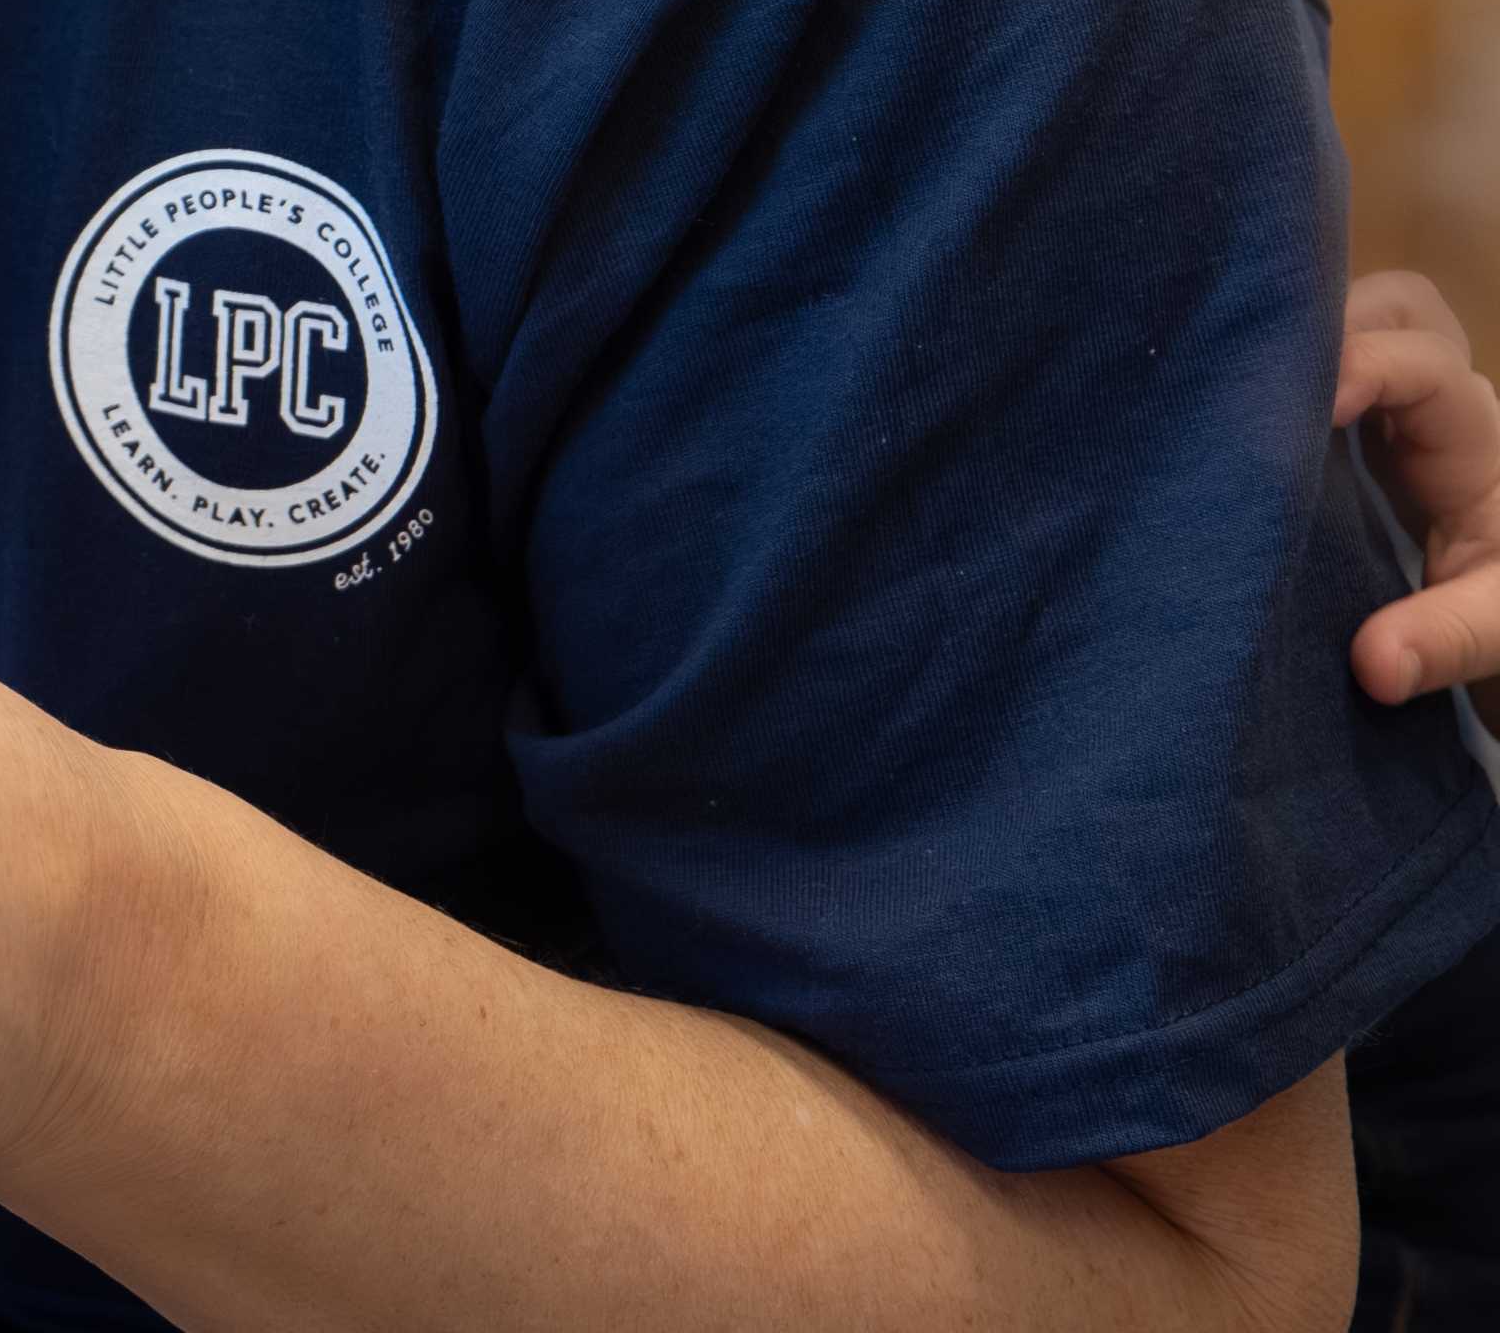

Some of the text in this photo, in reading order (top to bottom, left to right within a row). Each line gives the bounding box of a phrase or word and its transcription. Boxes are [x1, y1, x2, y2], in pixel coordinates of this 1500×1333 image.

[94, 188, 395, 353] LITTLE PEOPLE'S COLLEGE
[149, 276, 349, 440] LPC
[102, 404, 386, 528] LEARN. PLAY. CREATE.
[334, 508, 434, 591] est. 1980
